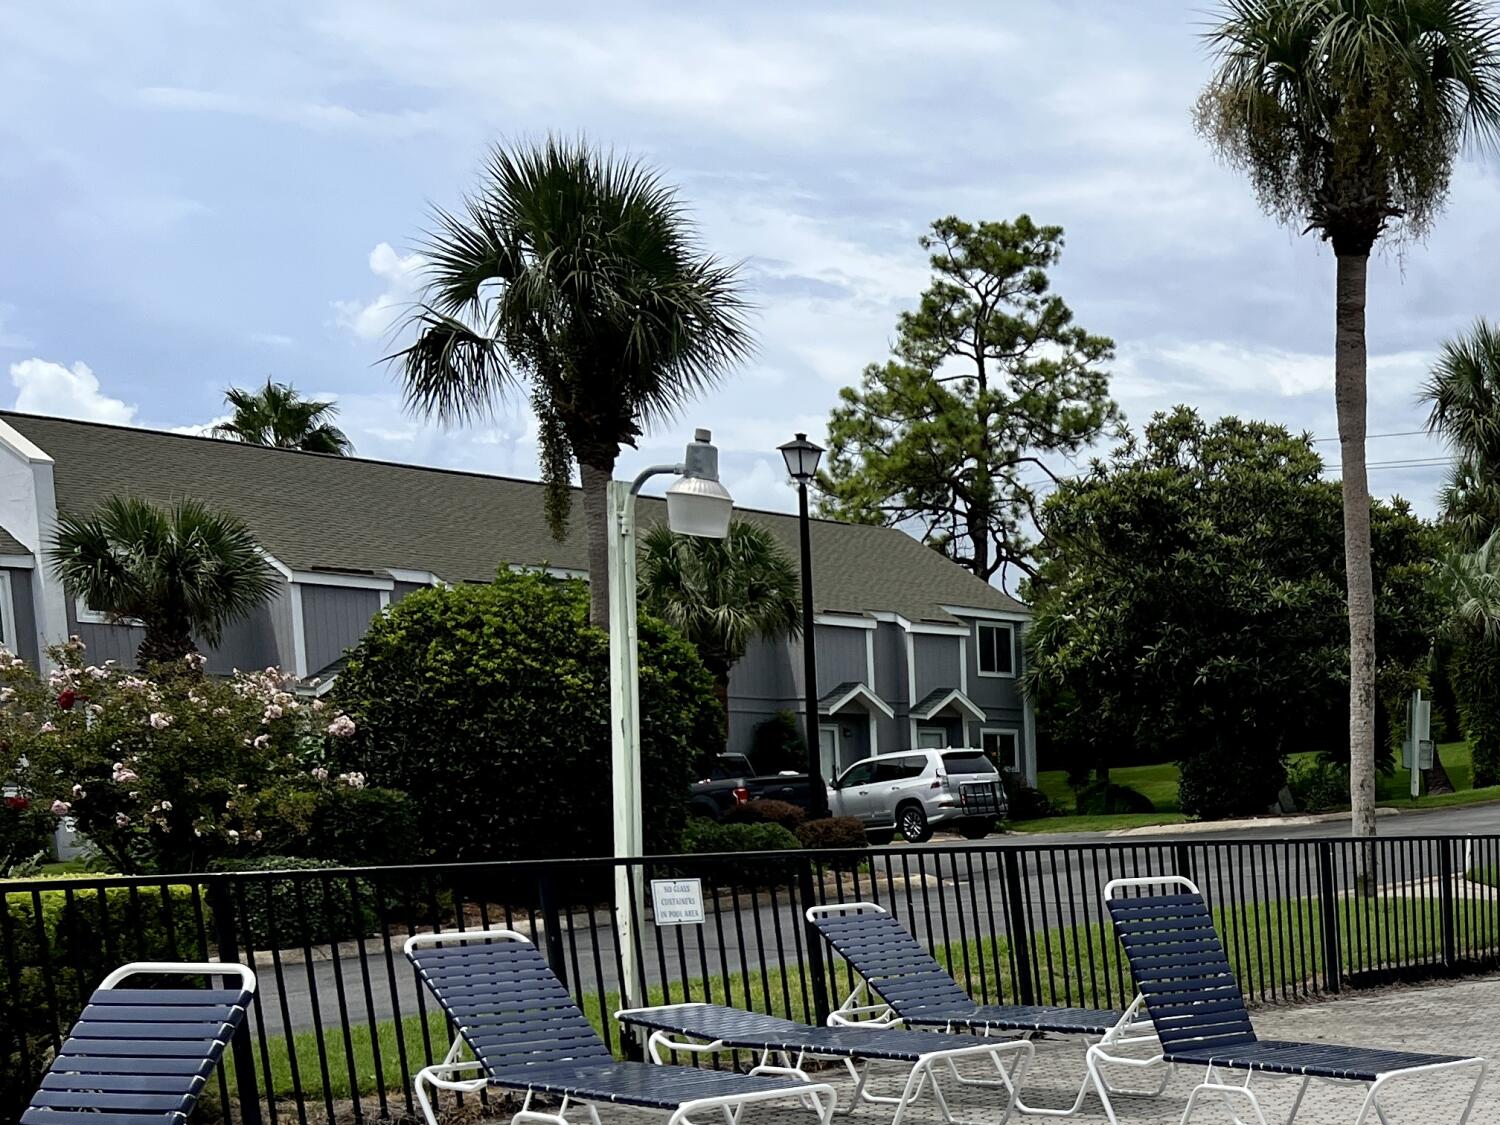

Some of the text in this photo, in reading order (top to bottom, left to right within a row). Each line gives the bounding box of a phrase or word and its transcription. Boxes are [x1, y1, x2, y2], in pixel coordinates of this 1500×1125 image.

[664, 885, 690, 893] NO GLASS
[661, 897, 695, 906] CONTAINERS
[668, 910, 683, 918] POOL
[684, 909, 699, 917] AREA
